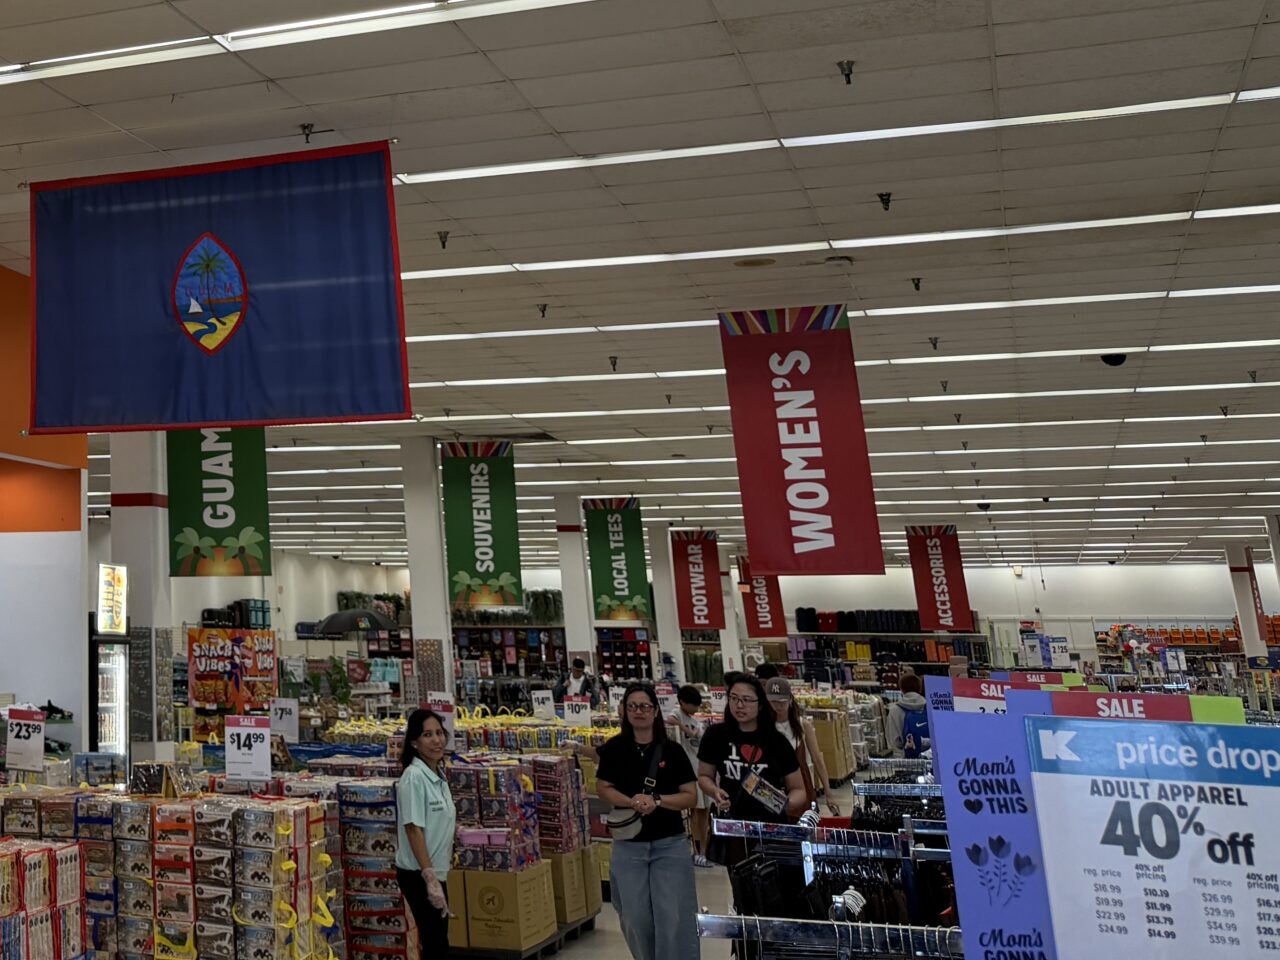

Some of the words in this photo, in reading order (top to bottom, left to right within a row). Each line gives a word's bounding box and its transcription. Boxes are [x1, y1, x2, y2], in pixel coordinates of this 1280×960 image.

[769, 350, 835, 554] WOMEN'S
[200, 427, 235, 529] GUAM
[470, 462, 495, 573] SOUVENIRS
[607, 513, 624, 548] TEES
[611, 552, 629, 596] LOCAL
[688, 544, 709, 624] FOOTWEAR
[926, 538, 954, 626] ACCESSORIES
[1096, 697, 1145, 718] SALE
[240, 718, 255, 726] SALE
[1115, 736, 1198, 770] price
[953, 755, 1015, 777] Mom's
[958, 779, 1022, 796] GONNA
[1090, 779, 1150, 800] ADULT
[1157, 783, 1248, 806] APPAREL
[986, 797, 1028, 814] THIS
[1100, 800, 1205, 860] 40%
[1207, 832, 1255, 866] off
[1083, 867, 1097, 877] reg.
[1101, 868, 1122, 878] price
[1136, 872, 1166, 882] pricing
[1135, 864, 1150, 872] 40%
[1152, 865, 1164, 873] off
[1246, 873, 1264, 881] 40%
[1265, 874, 1278, 882] off
[1193, 877, 1208, 887] reg.
[1211, 878, 1232, 888] price
[1247, 881, 1280, 892] pricing
[1096, 897, 1123, 907] $19.99
[1145, 901, 1172, 911] $11.99
[1204, 907, 1235, 918] $29.99
[1201, 892, 1233, 904] $26.99
[1096, 910, 1125, 921] $22.99
[1207, 921, 1238, 932] $34.99
[979, 927, 1043, 947] Mom's
[1098, 923, 1128, 934] $24.99
[1147, 929, 1176, 939] $14.99
[1209, 935, 1240, 946] $39.99
